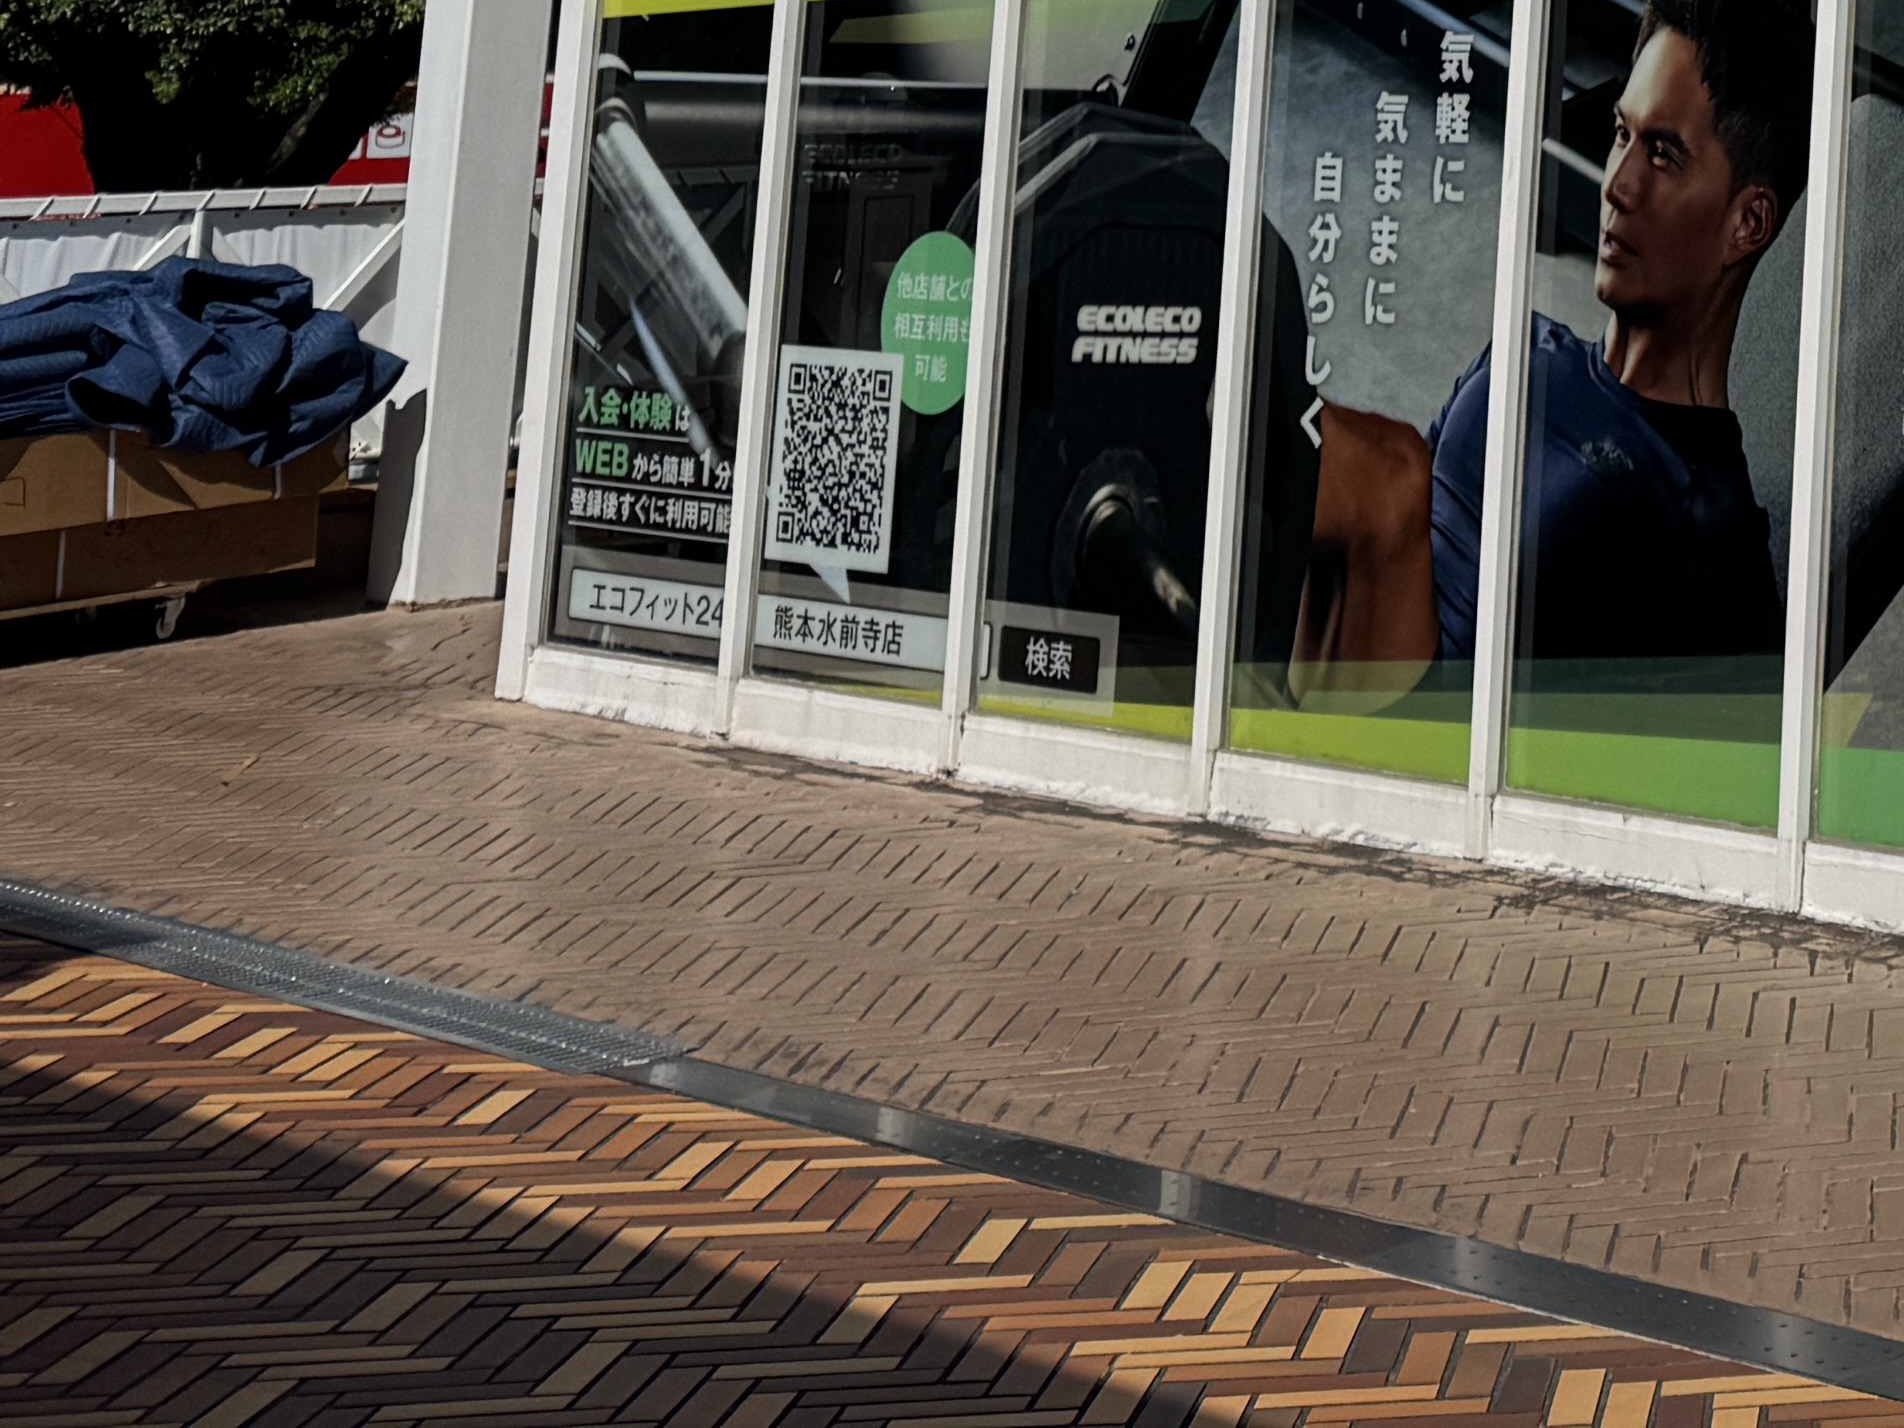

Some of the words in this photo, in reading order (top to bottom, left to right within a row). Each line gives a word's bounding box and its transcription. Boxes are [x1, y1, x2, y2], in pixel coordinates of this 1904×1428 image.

[1432, 30, 1474, 205] 気軽に
[1362, 90, 1409, 326] 気ままに
[897, 271, 973, 302] 他店舗との
[1299, 151, 1345, 450] 自分らしく
[914, 354, 947, 383] 可能
[1071, 335, 1199, 364] FITNESS
[569, 487, 731, 534] 登録後すぐに利用可能
[589, 583, 724, 629] エコフィット24
[773, 604, 904, 657] 熊本水前寺店
[1025, 636, 1073, 681] 検索
